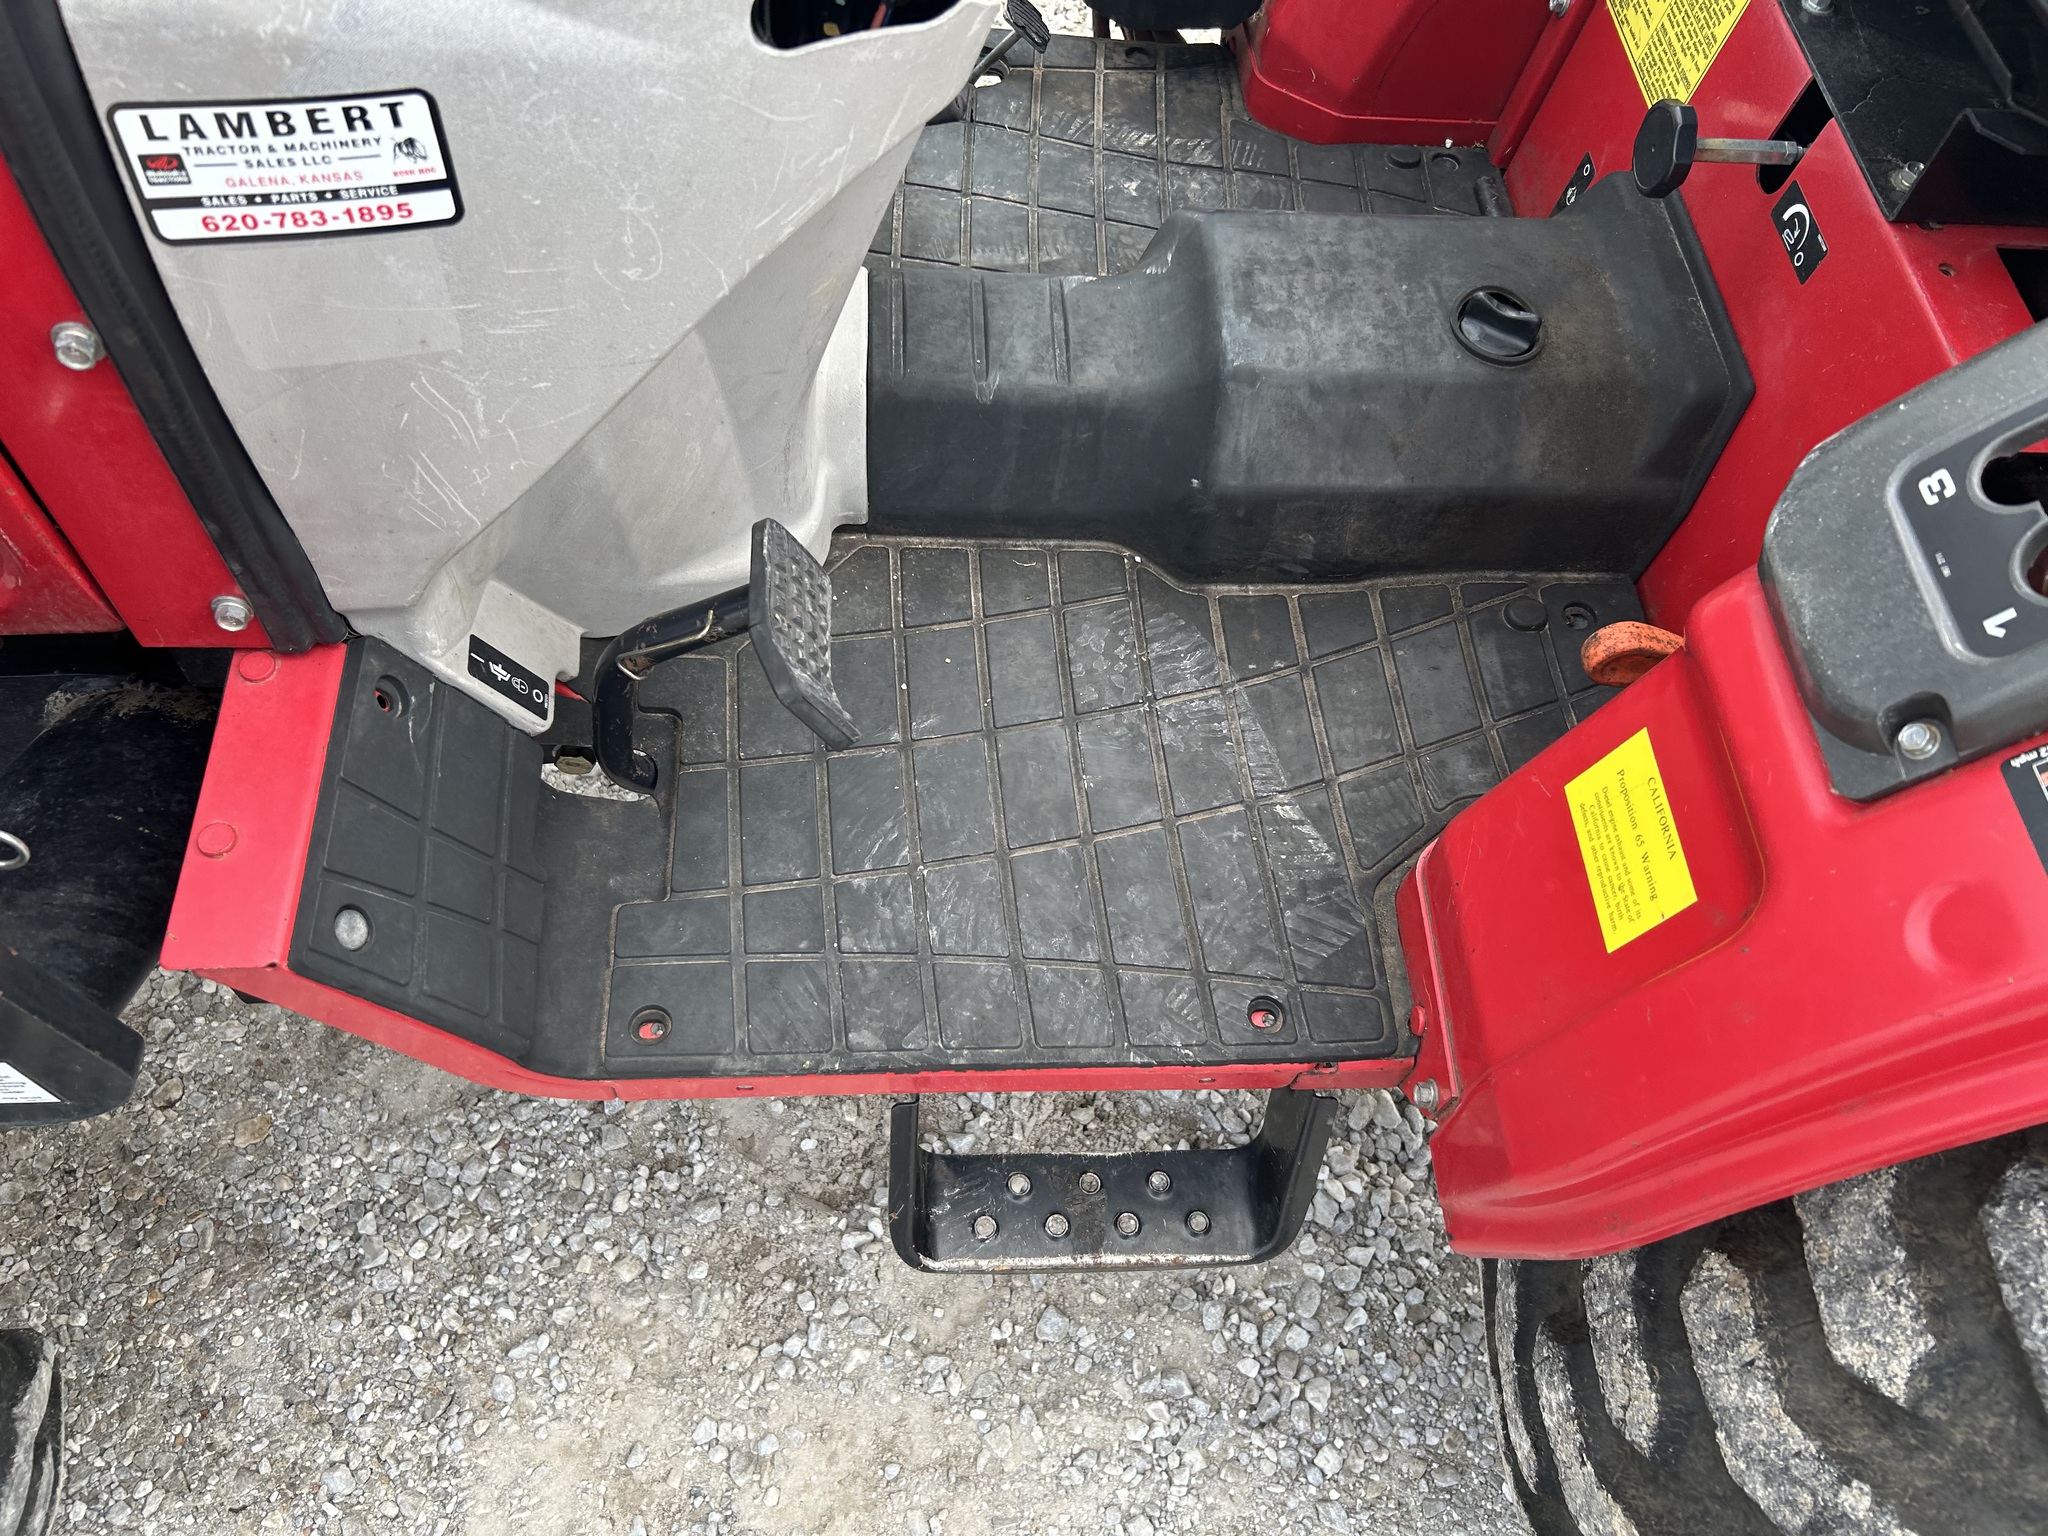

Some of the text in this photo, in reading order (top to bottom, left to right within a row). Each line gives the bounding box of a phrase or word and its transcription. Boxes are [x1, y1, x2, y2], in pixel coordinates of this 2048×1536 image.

[138, 101, 405, 141] LAMBERT
[182, 136, 383, 158] TRACTOR & MACHINERY
[244, 154, 333, 170] SALES LLC
[200, 184, 399, 208] SALES PARTS SERVICE
[299, 170, 365, 186] KANSAS
[201, 202, 414, 233] 620-783-1895
[1918, 468, 1957, 506] 3
[1982, 607, 2018, 639] 1
[2010, 750, 2038, 768] mph
[1617, 769, 1658, 901] Proposition 65 Warning
[1648, 777, 1676, 860] CALIFORNIA
[1594, 792, 1608, 832] constituents
[1609, 845, 1619, 871] known
[1622, 895, 1631, 914] State
[1602, 786, 1612, 808] Diesel
[1608, 810, 1618, 833] engine
[1615, 834, 1626, 861] exhaust
[1622, 862, 1631, 876] and
[1627, 878, 1635, 896] some
[1587, 829, 1595, 842] and
[1591, 845, 1599, 862] other
[1596, 865, 1611, 909] reproductive
[1589, 804, 1602, 840] California
[1602, 853, 1610, 873] cause
[1615, 901, 1624, 920] birth
